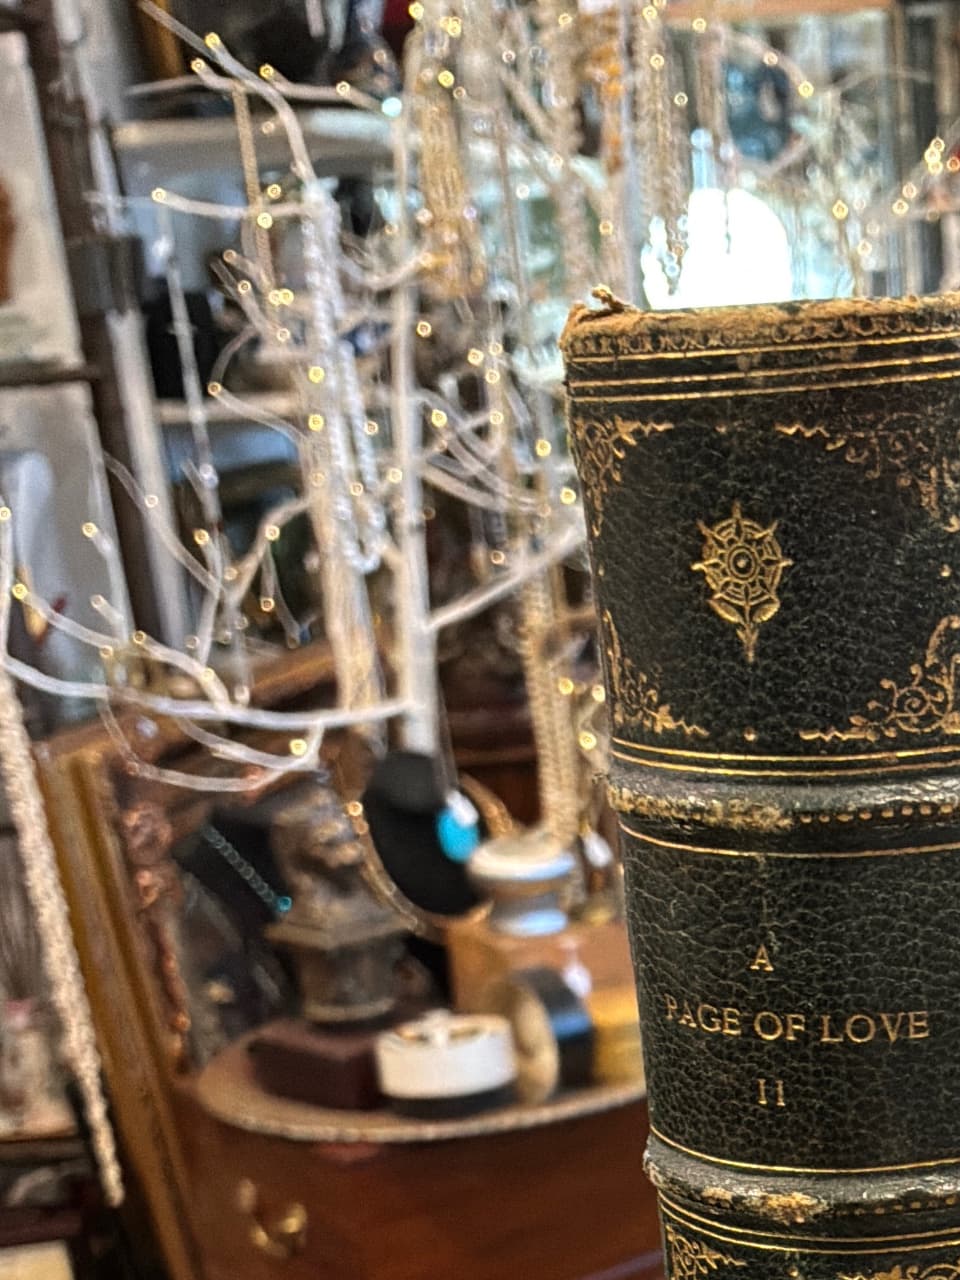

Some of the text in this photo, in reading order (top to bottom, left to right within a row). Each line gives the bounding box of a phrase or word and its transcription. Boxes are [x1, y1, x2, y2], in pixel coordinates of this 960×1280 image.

[750, 943, 774, 972] A
[663, 993, 931, 1044] PAGE OF LOVE
[757, 1078, 786, 1107] II
